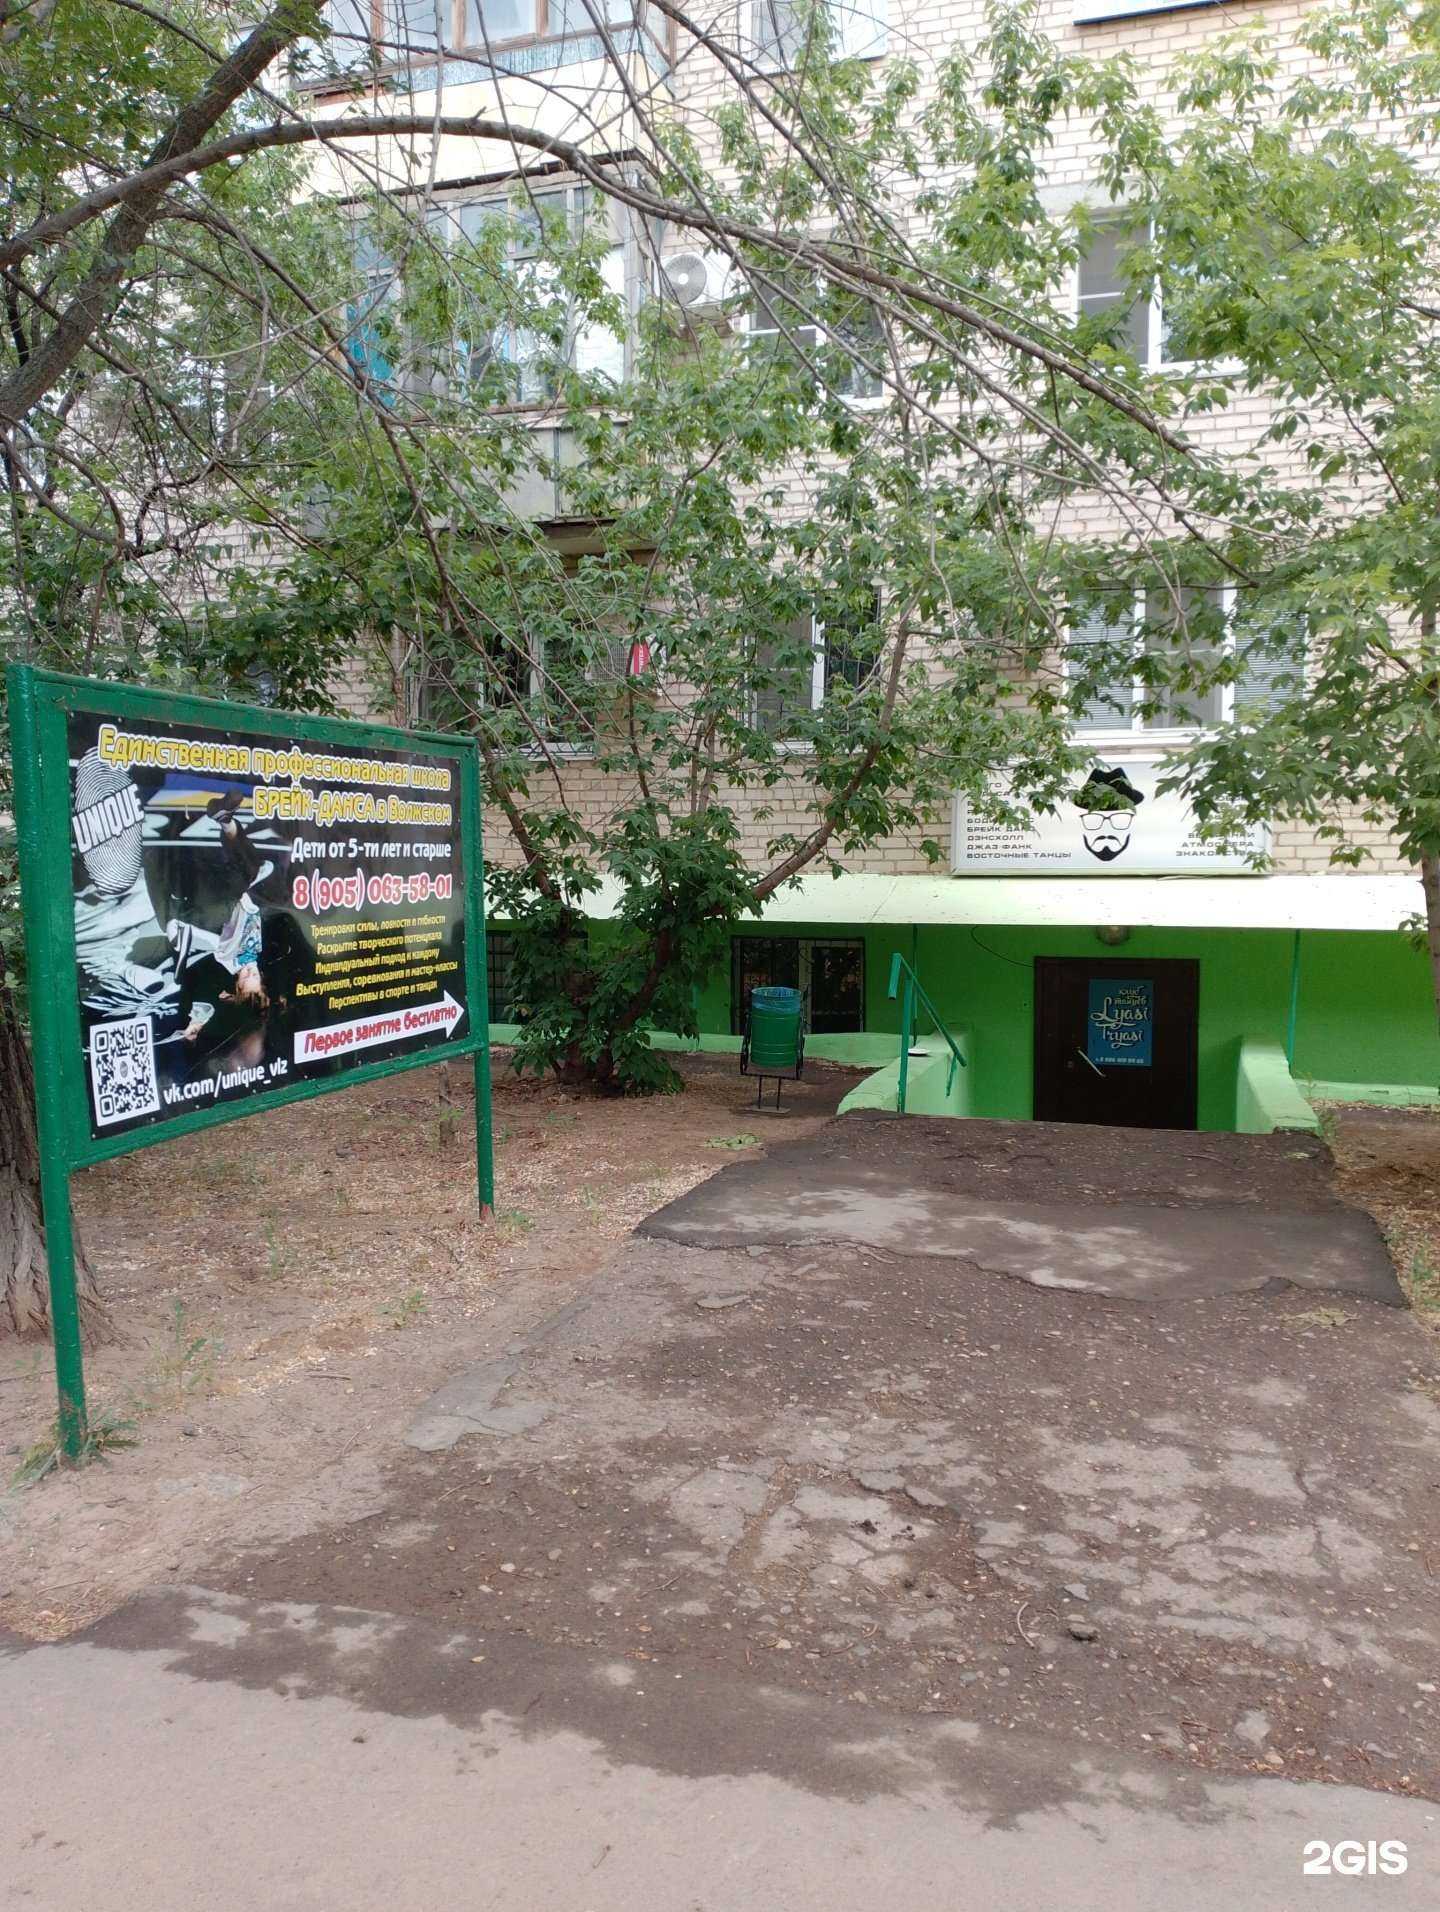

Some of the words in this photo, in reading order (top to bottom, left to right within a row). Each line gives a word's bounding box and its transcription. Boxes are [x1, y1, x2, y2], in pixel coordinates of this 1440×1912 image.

[99, 725, 250, 773] Единственная
[253, 748, 408, 786] профессиональная
[411, 765, 451, 790] школа
[72, 784, 145, 854] UNIQUE
[254, 785, 377, 826] БРЕЙК-ДАНСА
[378, 799, 386, 822] в
[388, 796, 451, 824] Волжском
[291, 838, 326, 862] Дети
[329, 844, 345, 857] от
[350, 838, 379, 858] 5-ти
[381, 844, 401, 857] лет
[402, 845, 410, 857] и
[413, 843, 451, 861] старше
[368, 872, 452, 904] 063-58-01
[310, 923, 356, 938] Тренировки
[357, 921, 379, 931] силы,
[381, 919, 411, 930] ловкости
[417, 914, 445, 926] гибкости
[317, 941, 358, 955] Раскрытие
[359, 936, 403, 950] творческого
[405, 931, 442, 944] потенциала
[315, 954, 379, 975] Индивидуальный
[381, 953, 406, 966] подход
[412, 948, 440, 960] каждому
[296, 978, 352, 996] Выступления,
[353, 970, 404, 987] соревнования
[411, 961, 458, 976] мастер-классы
[329, 992, 378, 1010] Перспективы
[385, 985, 409, 999] спорте
[304, 1027, 354, 1054] Первое
[356, 1019, 401, 1041] занятие
[404, 1005, 457, 1030] бесплатно
[163, 1058, 288, 1105] vk.com/unique_vlz
